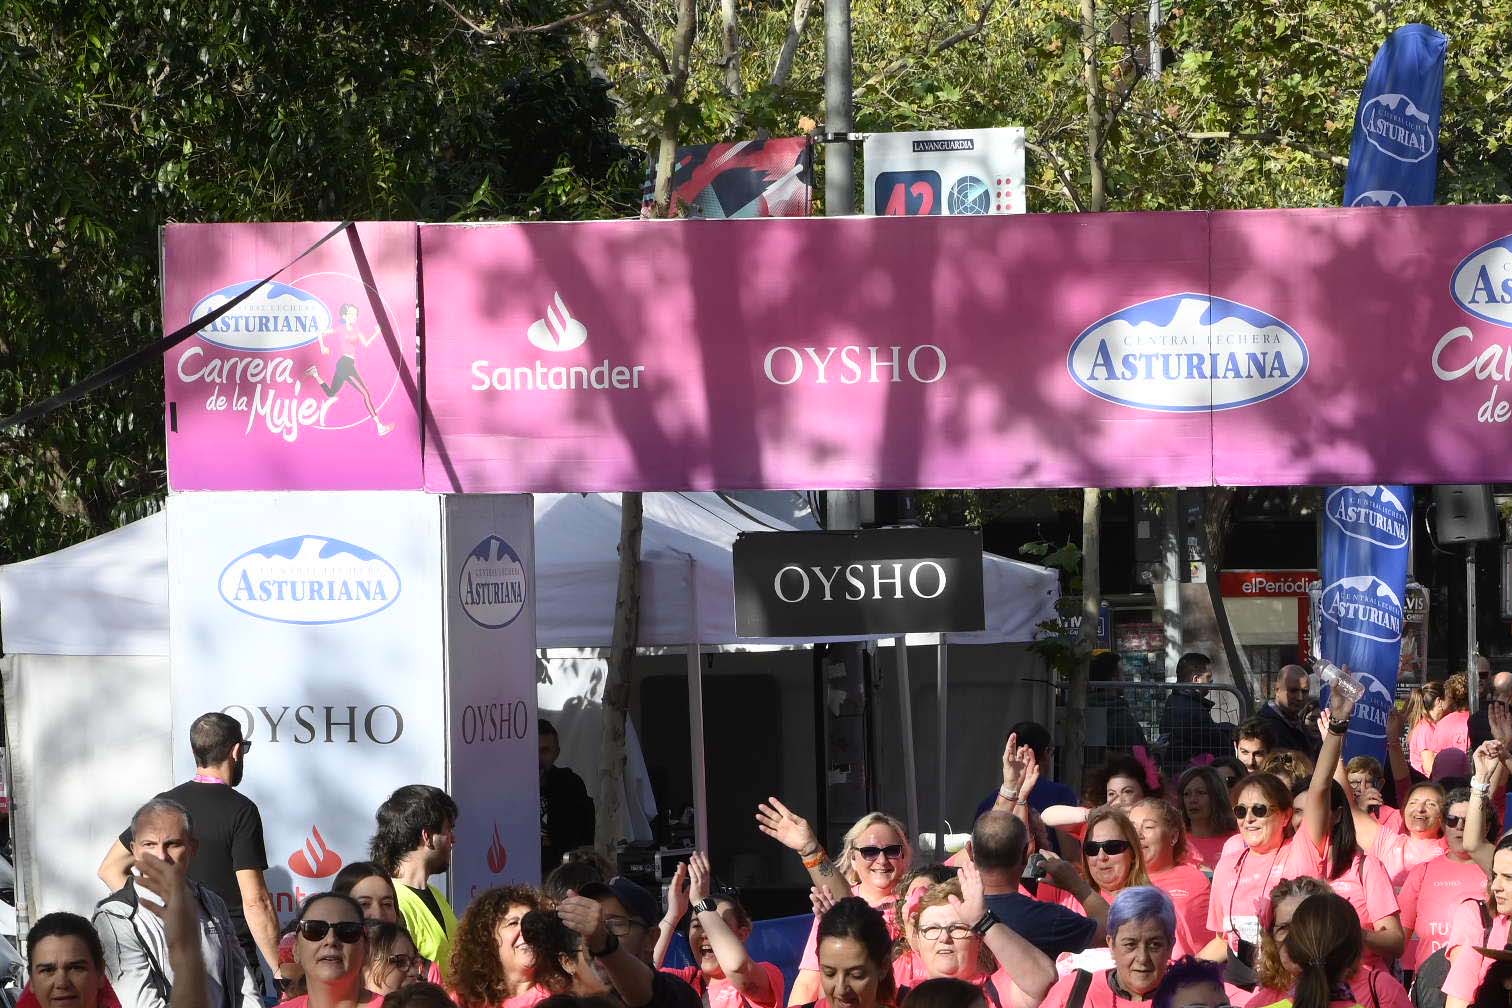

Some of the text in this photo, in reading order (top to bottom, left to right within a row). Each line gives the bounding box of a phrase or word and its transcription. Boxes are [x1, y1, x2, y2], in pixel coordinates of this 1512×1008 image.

[1087, 338, 1290, 381] ASTURIANA
[1123, 333, 1281, 347] CENTRAL LECHERA
[177, 346, 293, 384] Carrera
[471, 358, 645, 391] Santander
[764, 344, 947, 385] OYSHO
[206, 380, 338, 442] de la Mujer
[1478, 384, 1511, 423] de
[1335, 496, 1406, 541] ASTURIANA
[232, 568, 389, 602] ASTURIANA
[465, 570, 522, 606] ASTURIANA
[774, 560, 948, 606] OYSHO
[1328, 591, 1400, 634] ASTURIANA
[461, 700, 528, 746] OYSHO
[1430, 922, 1448, 937] TU
